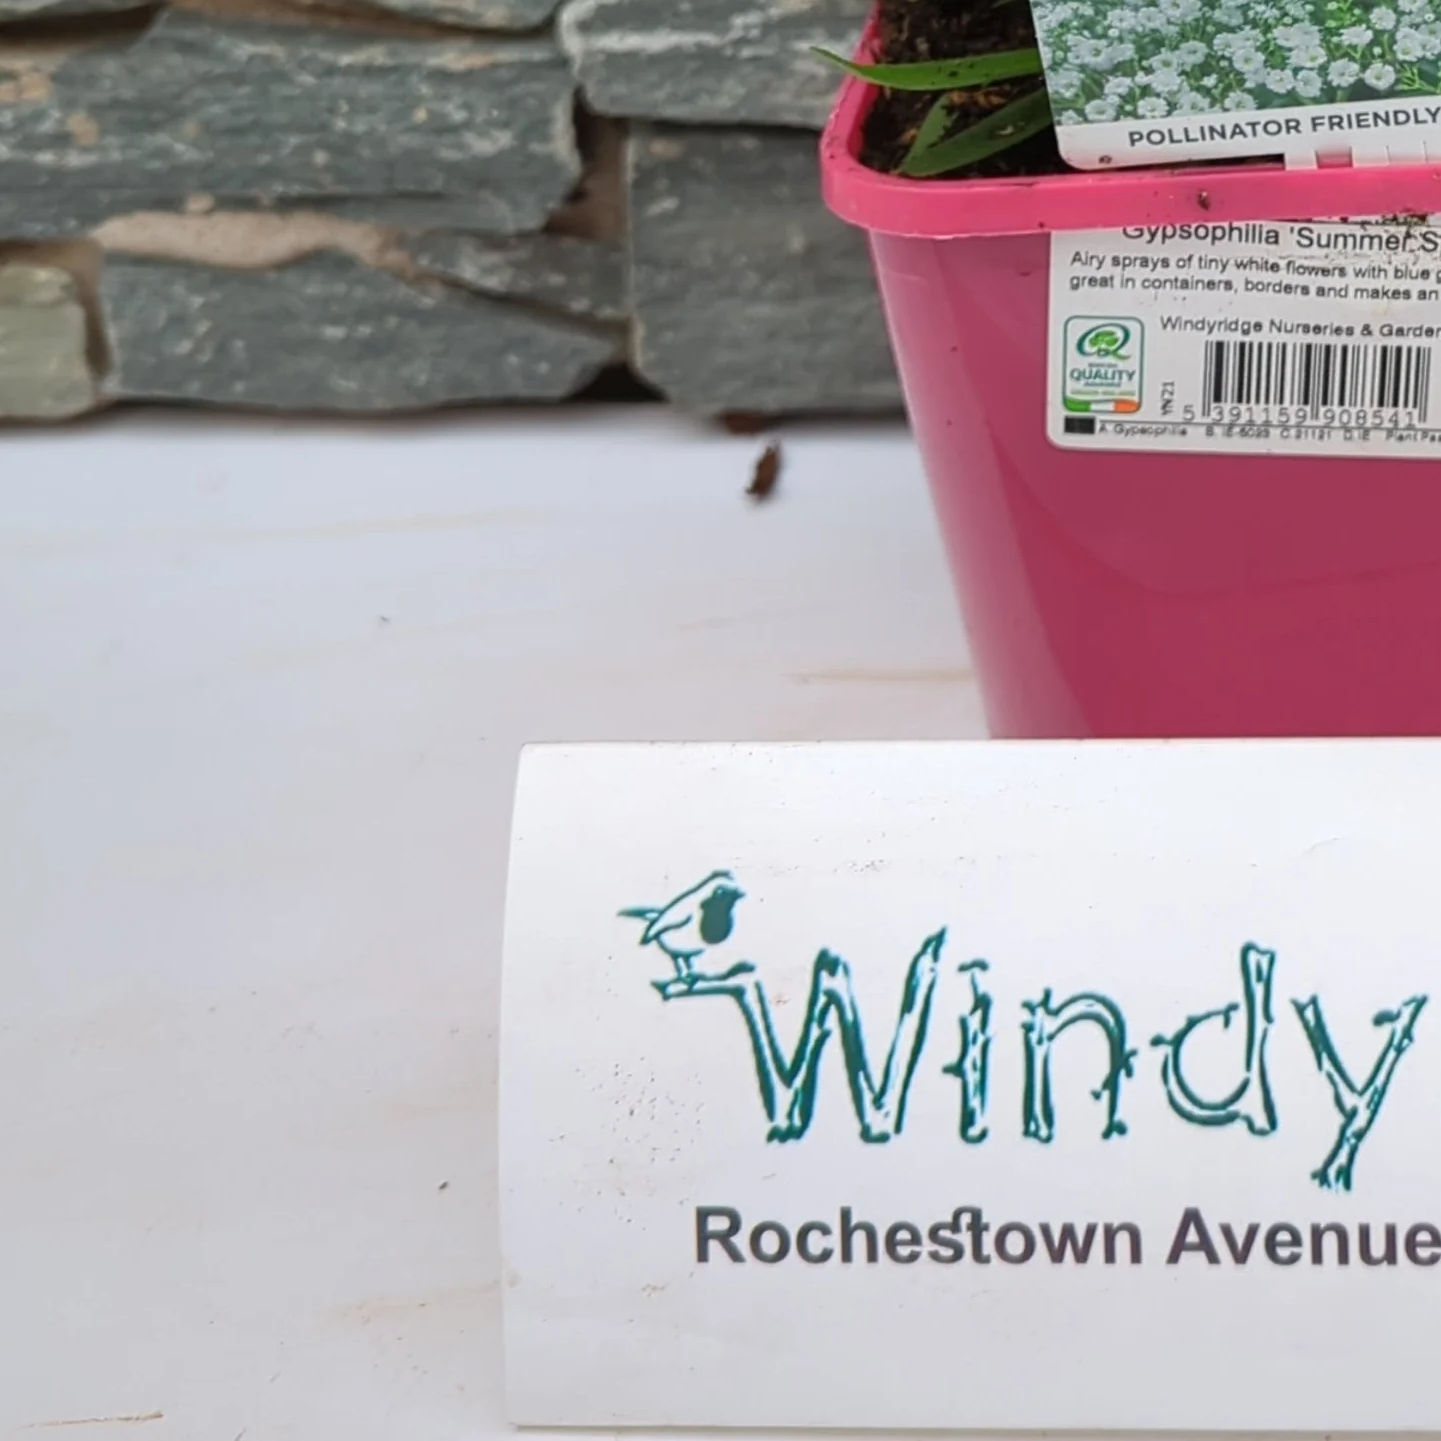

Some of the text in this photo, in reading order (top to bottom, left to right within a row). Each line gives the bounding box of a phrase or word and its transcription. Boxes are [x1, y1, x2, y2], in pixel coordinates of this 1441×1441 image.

[1128, 118, 1302, 147] POLLINATOR
[1311, 106, 1441, 134] FRIENDLY
[1070, 251, 1104, 270] Airy
[1112, 256, 1171, 271] sprays
[1176, 253, 1194, 269] of
[1198, 255, 1229, 273] tiny
[1235, 256, 1281, 273] white
[1286, 258, 1348, 277] flowers
[1354, 264, 1389, 280] with
[1394, 264, 1430, 281] blue
[1070, 274, 1114, 292] great
[1120, 275, 1135, 289] in
[1141, 275, 1239, 294] containers,
[1244, 278, 1310, 296] borders
[1316, 282, 1348, 299] and
[1354, 283, 1411, 300] makes
[1417, 288, 1439, 301] an
[1160, 315, 1263, 336] Windyridge
[1269, 318, 1354, 336] Nurseries
[1360, 323, 1373, 337] &
[1069, 368, 1136, 382] QUALITY
[1183, 405, 1416, 429] 5 391159 908541
[695, 1205, 1142, 1267] Rochestown
